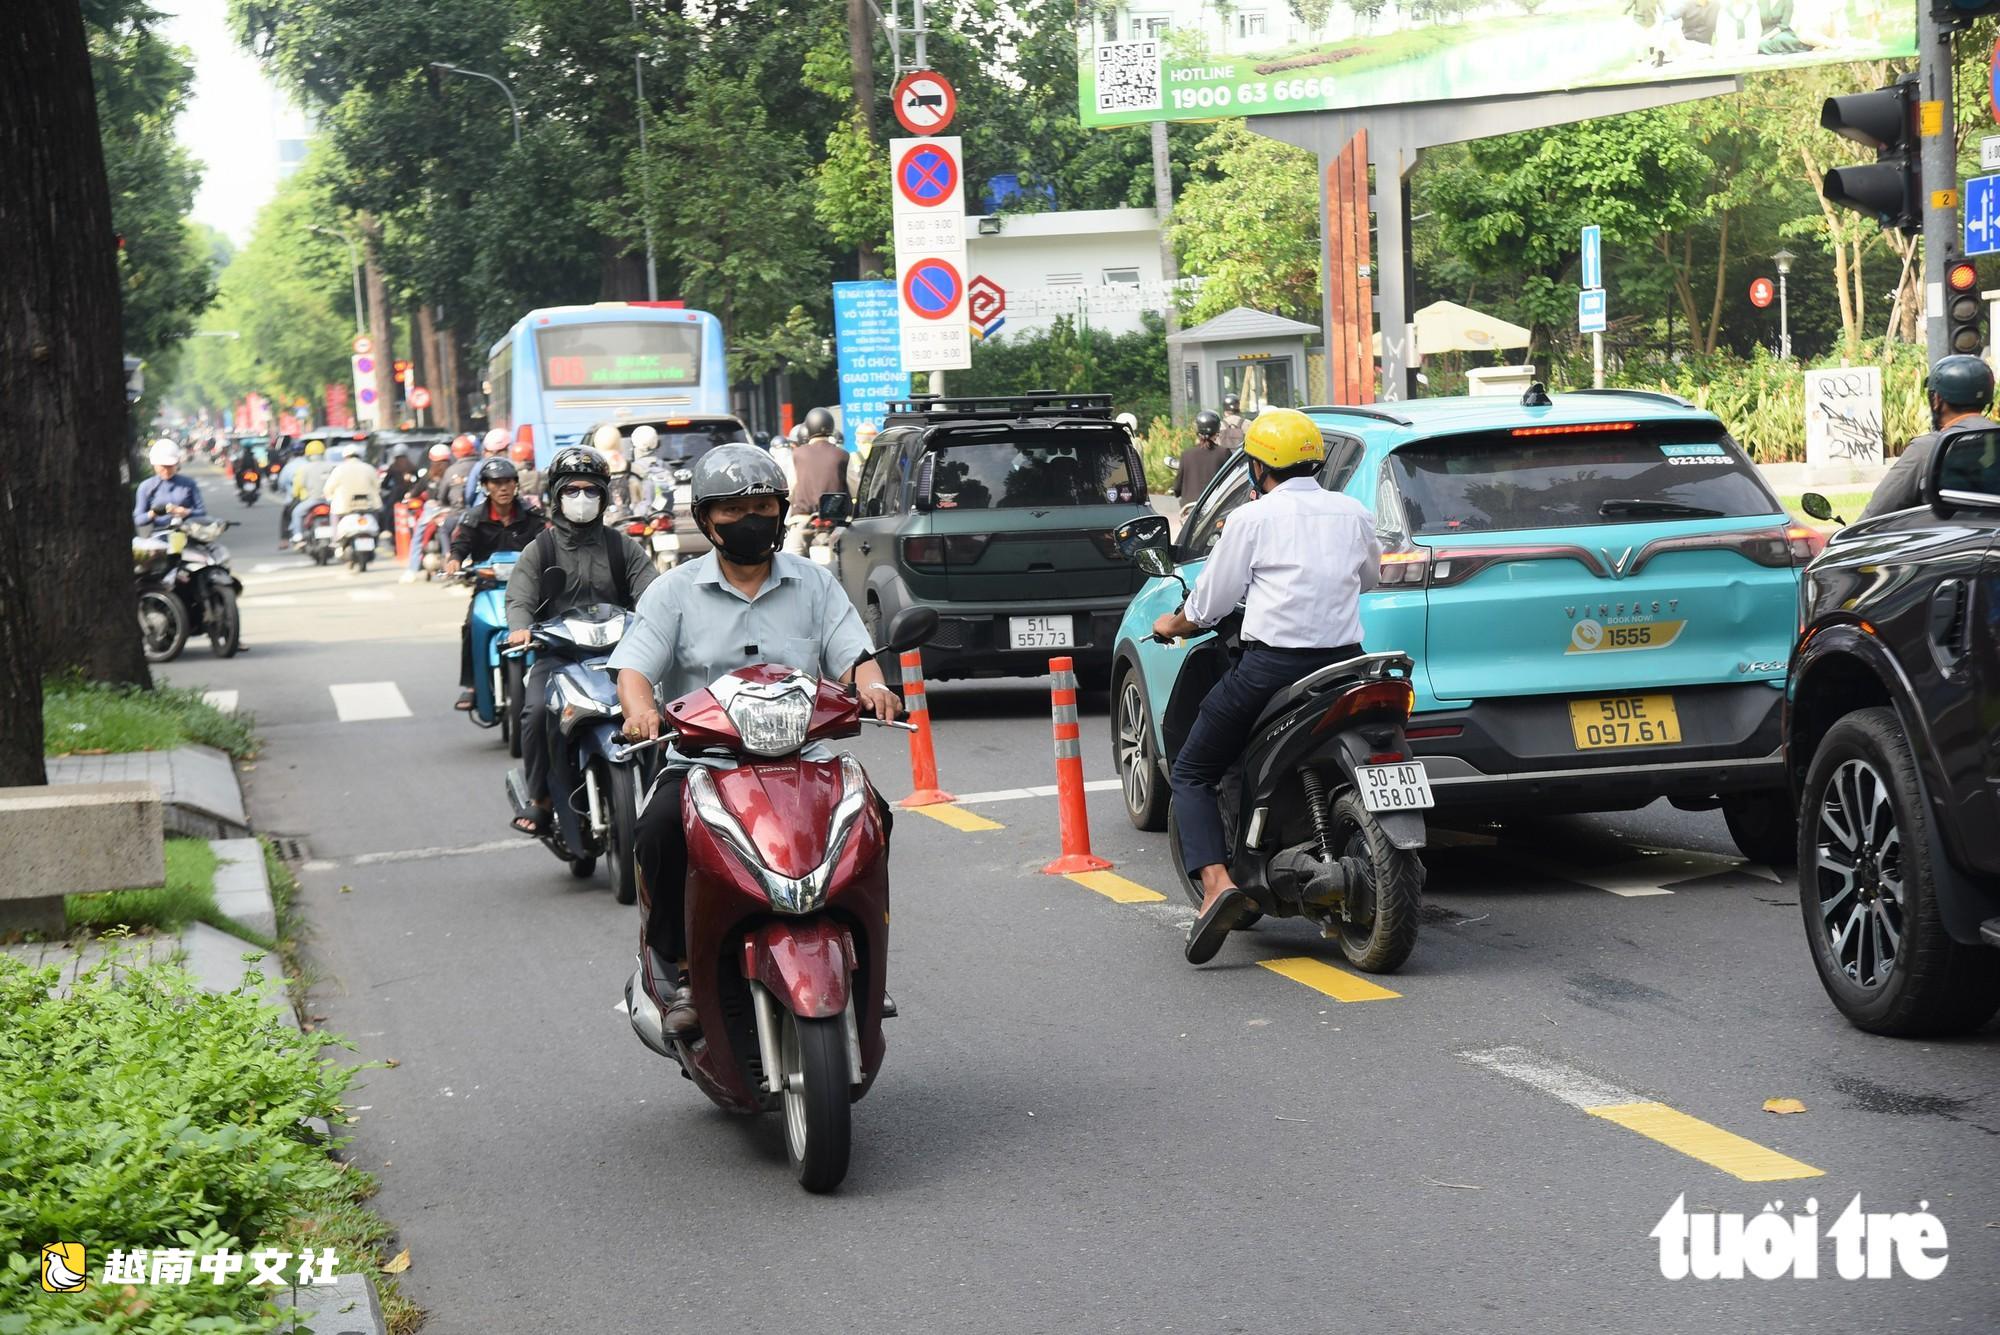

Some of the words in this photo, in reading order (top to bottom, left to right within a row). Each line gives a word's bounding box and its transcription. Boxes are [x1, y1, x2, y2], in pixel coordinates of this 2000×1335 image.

[1171, 65, 1235, 82] HOTLINE
[1171, 86, 1231, 109] 1900
[1237, 83, 1268, 105] 63
[1274, 76, 1336, 101] 6666
[1942, 193, 1950, 206] 2
[867, 355, 897, 367] CHỨC
[843, 372, 869, 383] GIAO
[870, 371, 907, 383] THÔNG
[846, 402, 861, 412] XE
[741, 485, 775, 496] Andes
[1564, 599, 1679, 619] VINFAST
[1027, 618, 1055, 632] 51L
[1607, 616, 1630, 625] BOOK
[1018, 632, 1066, 647] 557.73
[1607, 627, 1651, 647] 1555
[1600, 698, 1647, 721] 50E
[1586, 720, 1668, 746] 097.61
[758, 766, 796, 774] HONDA
[1366, 766, 1417, 788] 50-AD
[1369, 786, 1427, 809] 158.01
